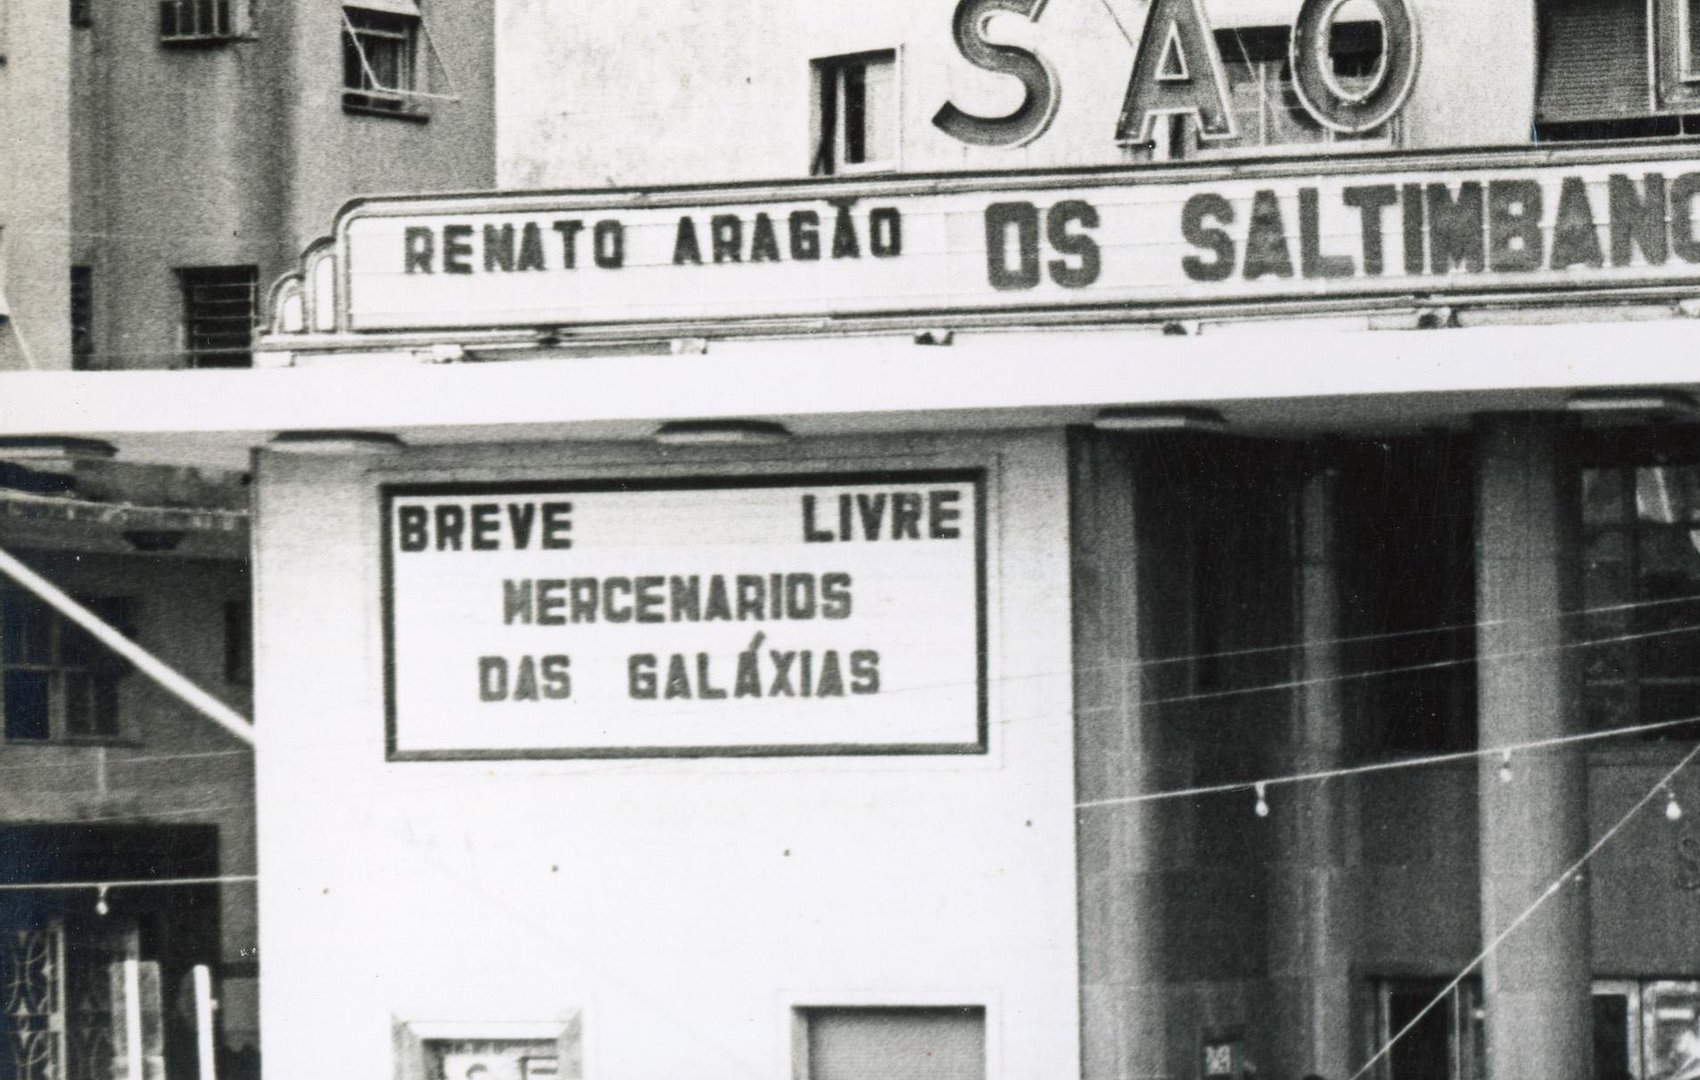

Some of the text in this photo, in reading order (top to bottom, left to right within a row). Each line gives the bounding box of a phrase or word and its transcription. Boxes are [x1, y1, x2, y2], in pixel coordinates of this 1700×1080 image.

[404, 219, 625, 275] RENATO
[673, 197, 901, 264] ARAGÃO
[984, 199, 1101, 291] OS
[400, 490, 961, 553] BREVE LIVRE
[503, 572, 853, 625] MERCENARIOS
[479, 630, 880, 702] DAS GALÁXIAS
